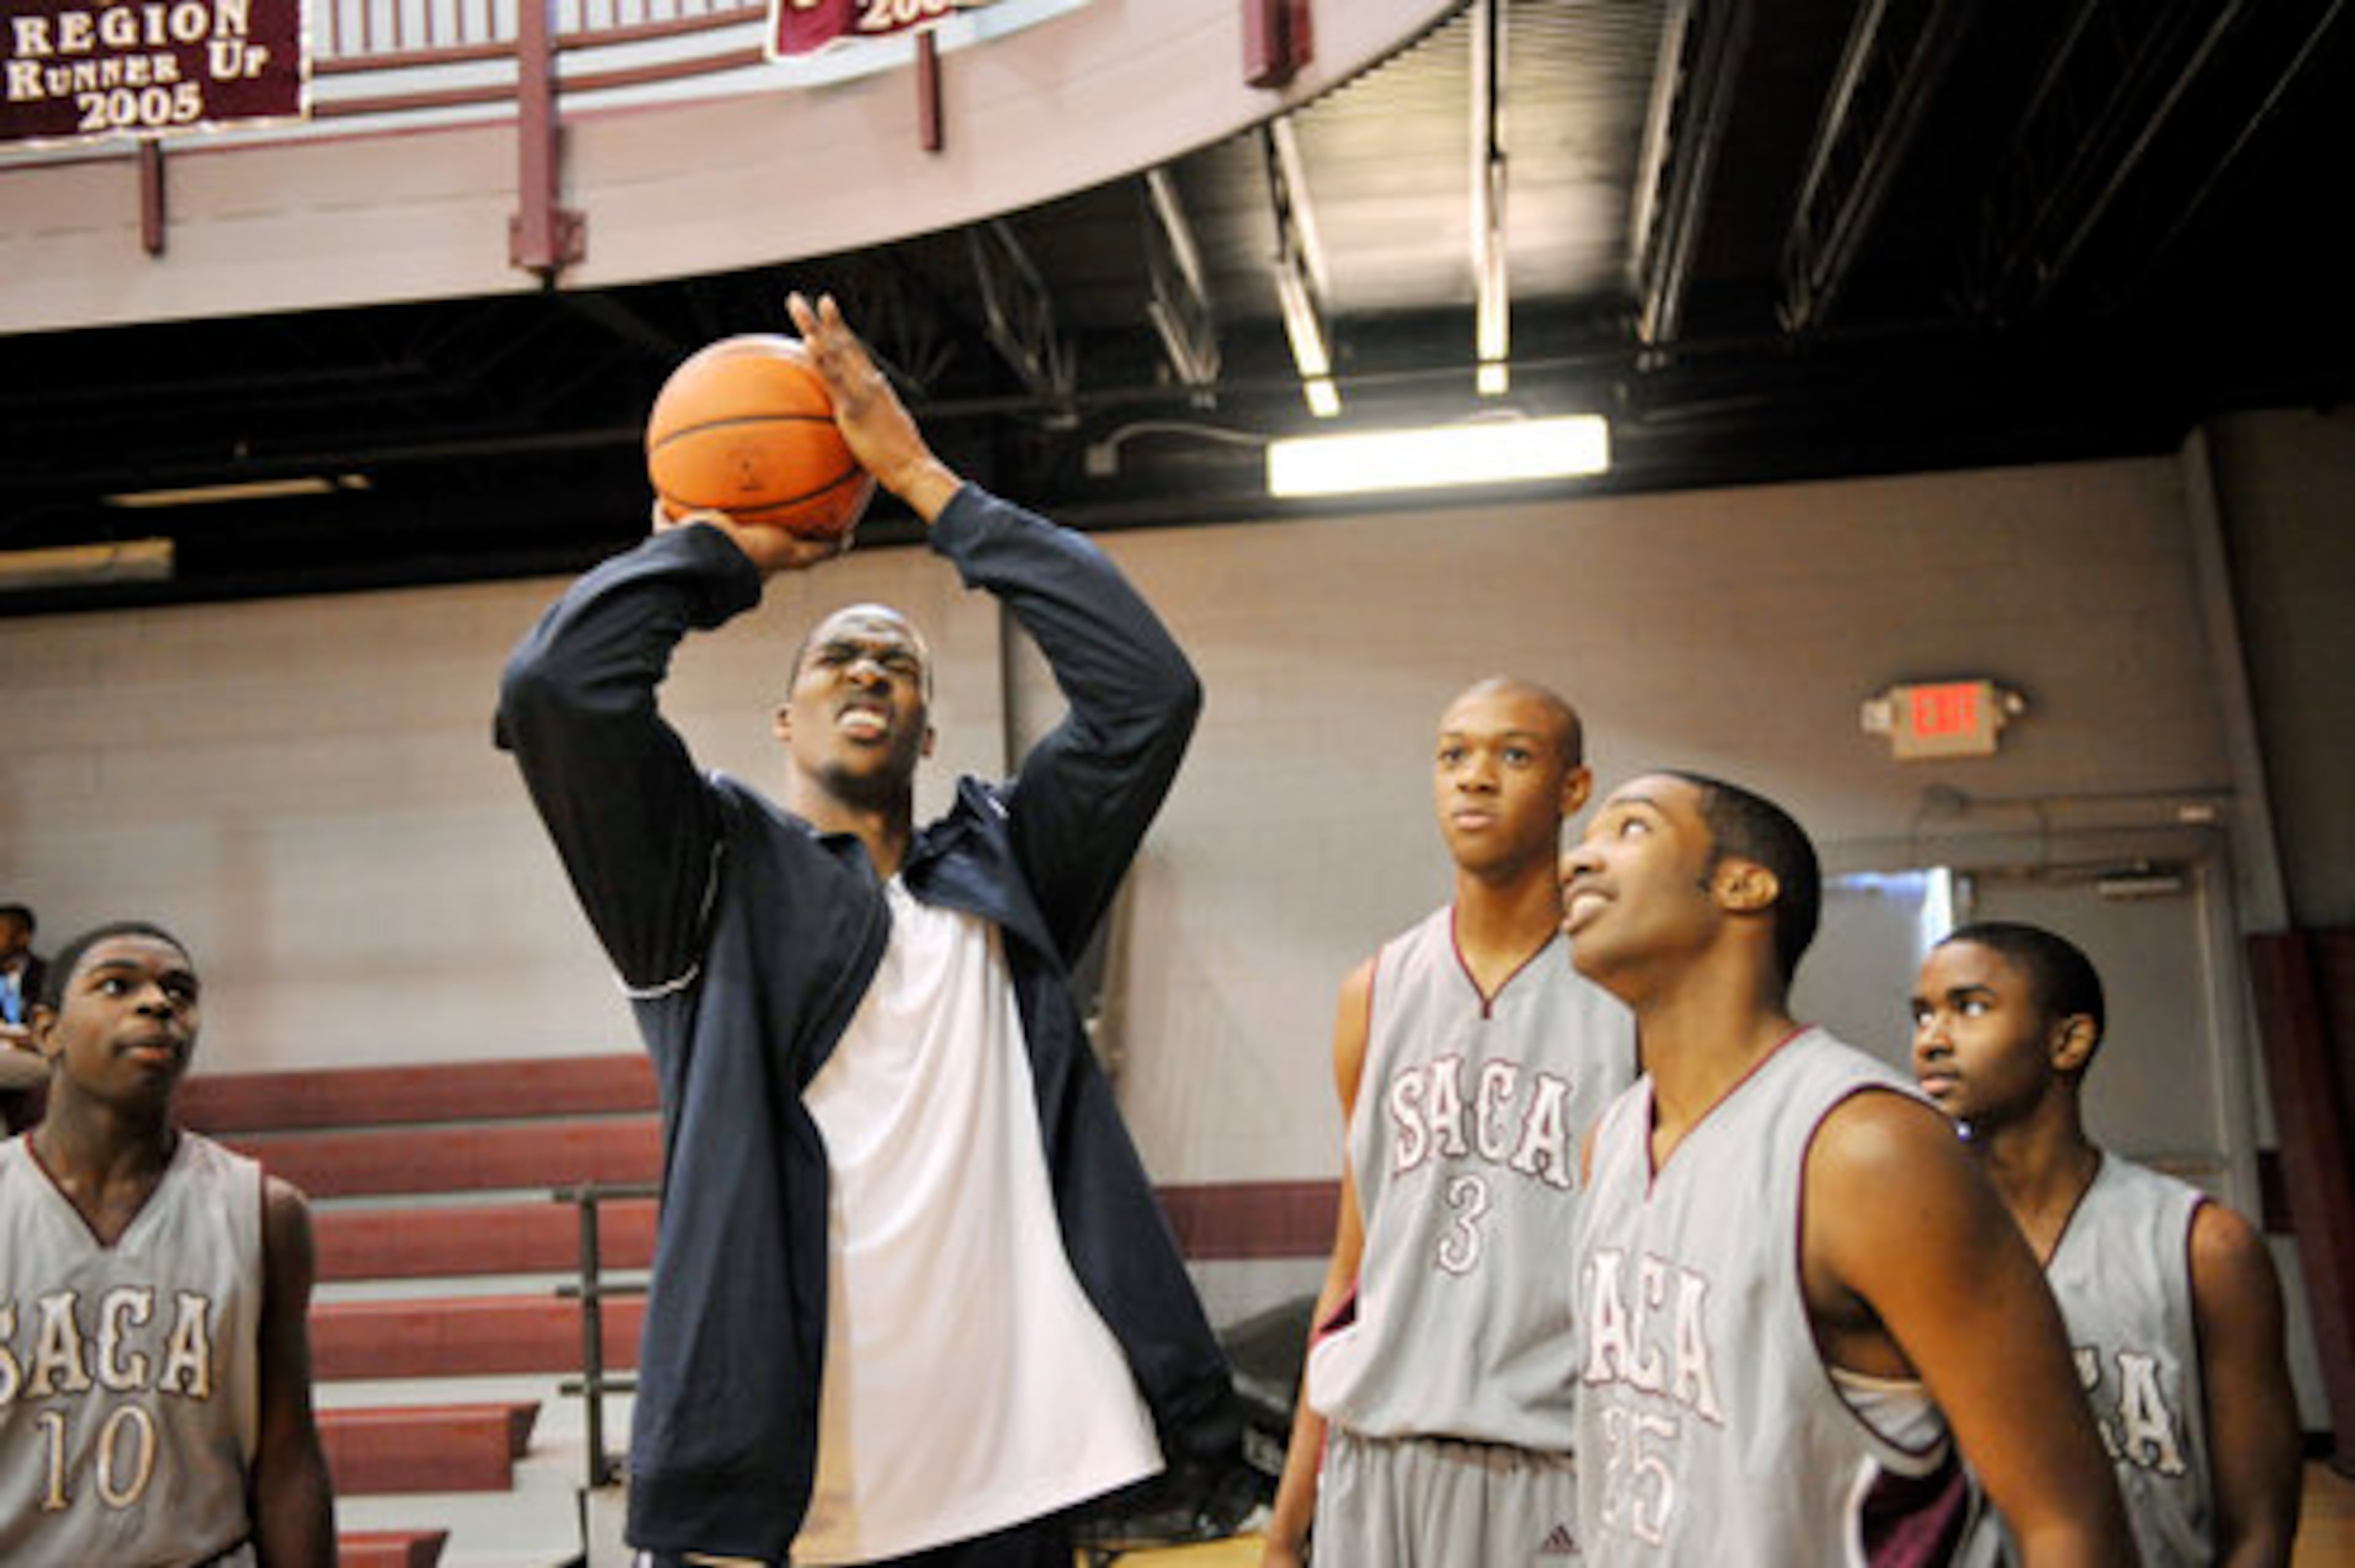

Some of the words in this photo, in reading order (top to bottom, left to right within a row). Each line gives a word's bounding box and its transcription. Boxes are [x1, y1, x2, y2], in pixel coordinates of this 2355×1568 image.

[7, 54, 182, 101] RUNNER
[11, 0, 248, 57] REGION
[77, 82, 202, 131] 2005
[1390, 1053, 1571, 1190] SACA
[1436, 1174, 1488, 1277] 3
[1581, 1247, 1725, 1429] ACA
[37, 1404, 157, 1512] 10
